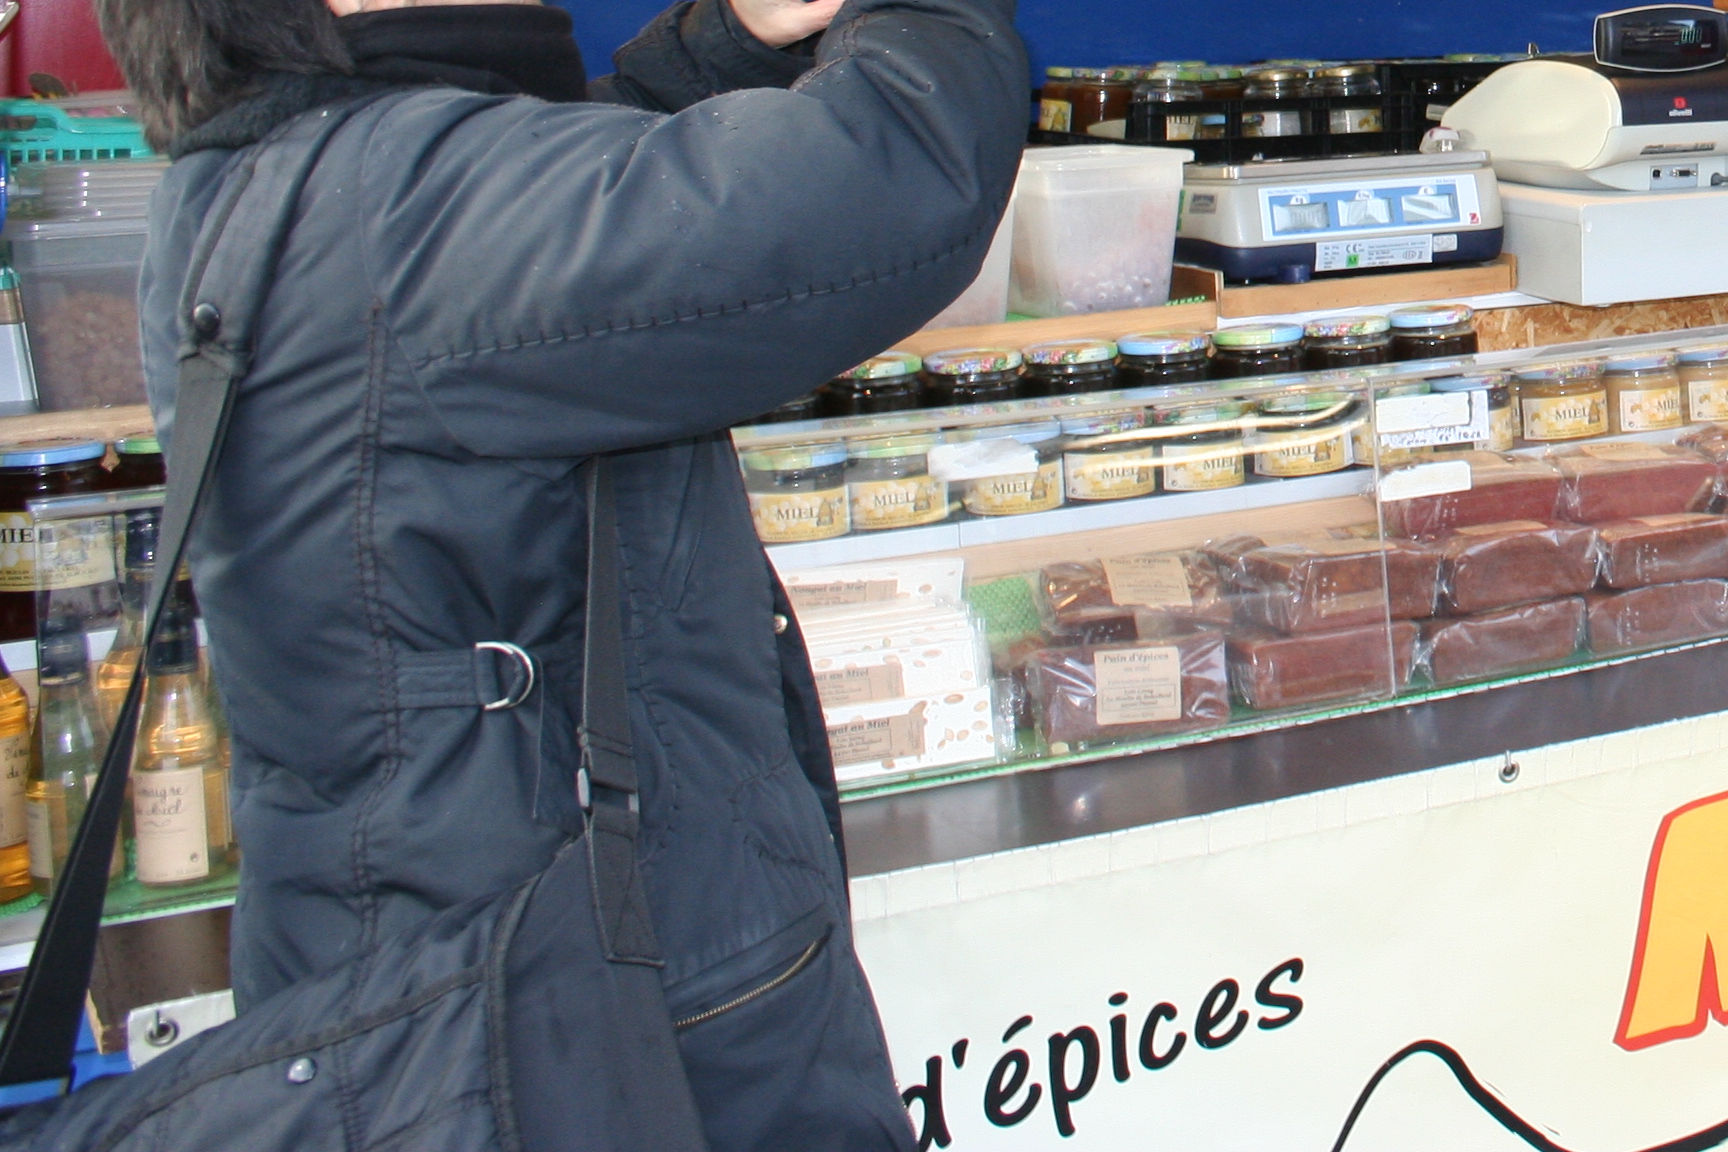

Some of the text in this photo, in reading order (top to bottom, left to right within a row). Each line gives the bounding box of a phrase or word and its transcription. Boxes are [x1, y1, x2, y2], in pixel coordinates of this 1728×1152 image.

[1555, 407, 1589, 421] MIEL
[1278, 445, 1316, 458] MIEL
[1202, 457, 1237, 471] MIEL
[1101, 467, 1141, 480] MIEL
[992, 480, 1034, 495] MIEL
[873, 491, 916, 507] MIEL
[776, 507, 819, 521] MIEL
[867, 718, 891, 729] Miel
[901, 957, 1304, 1152] d'épices
